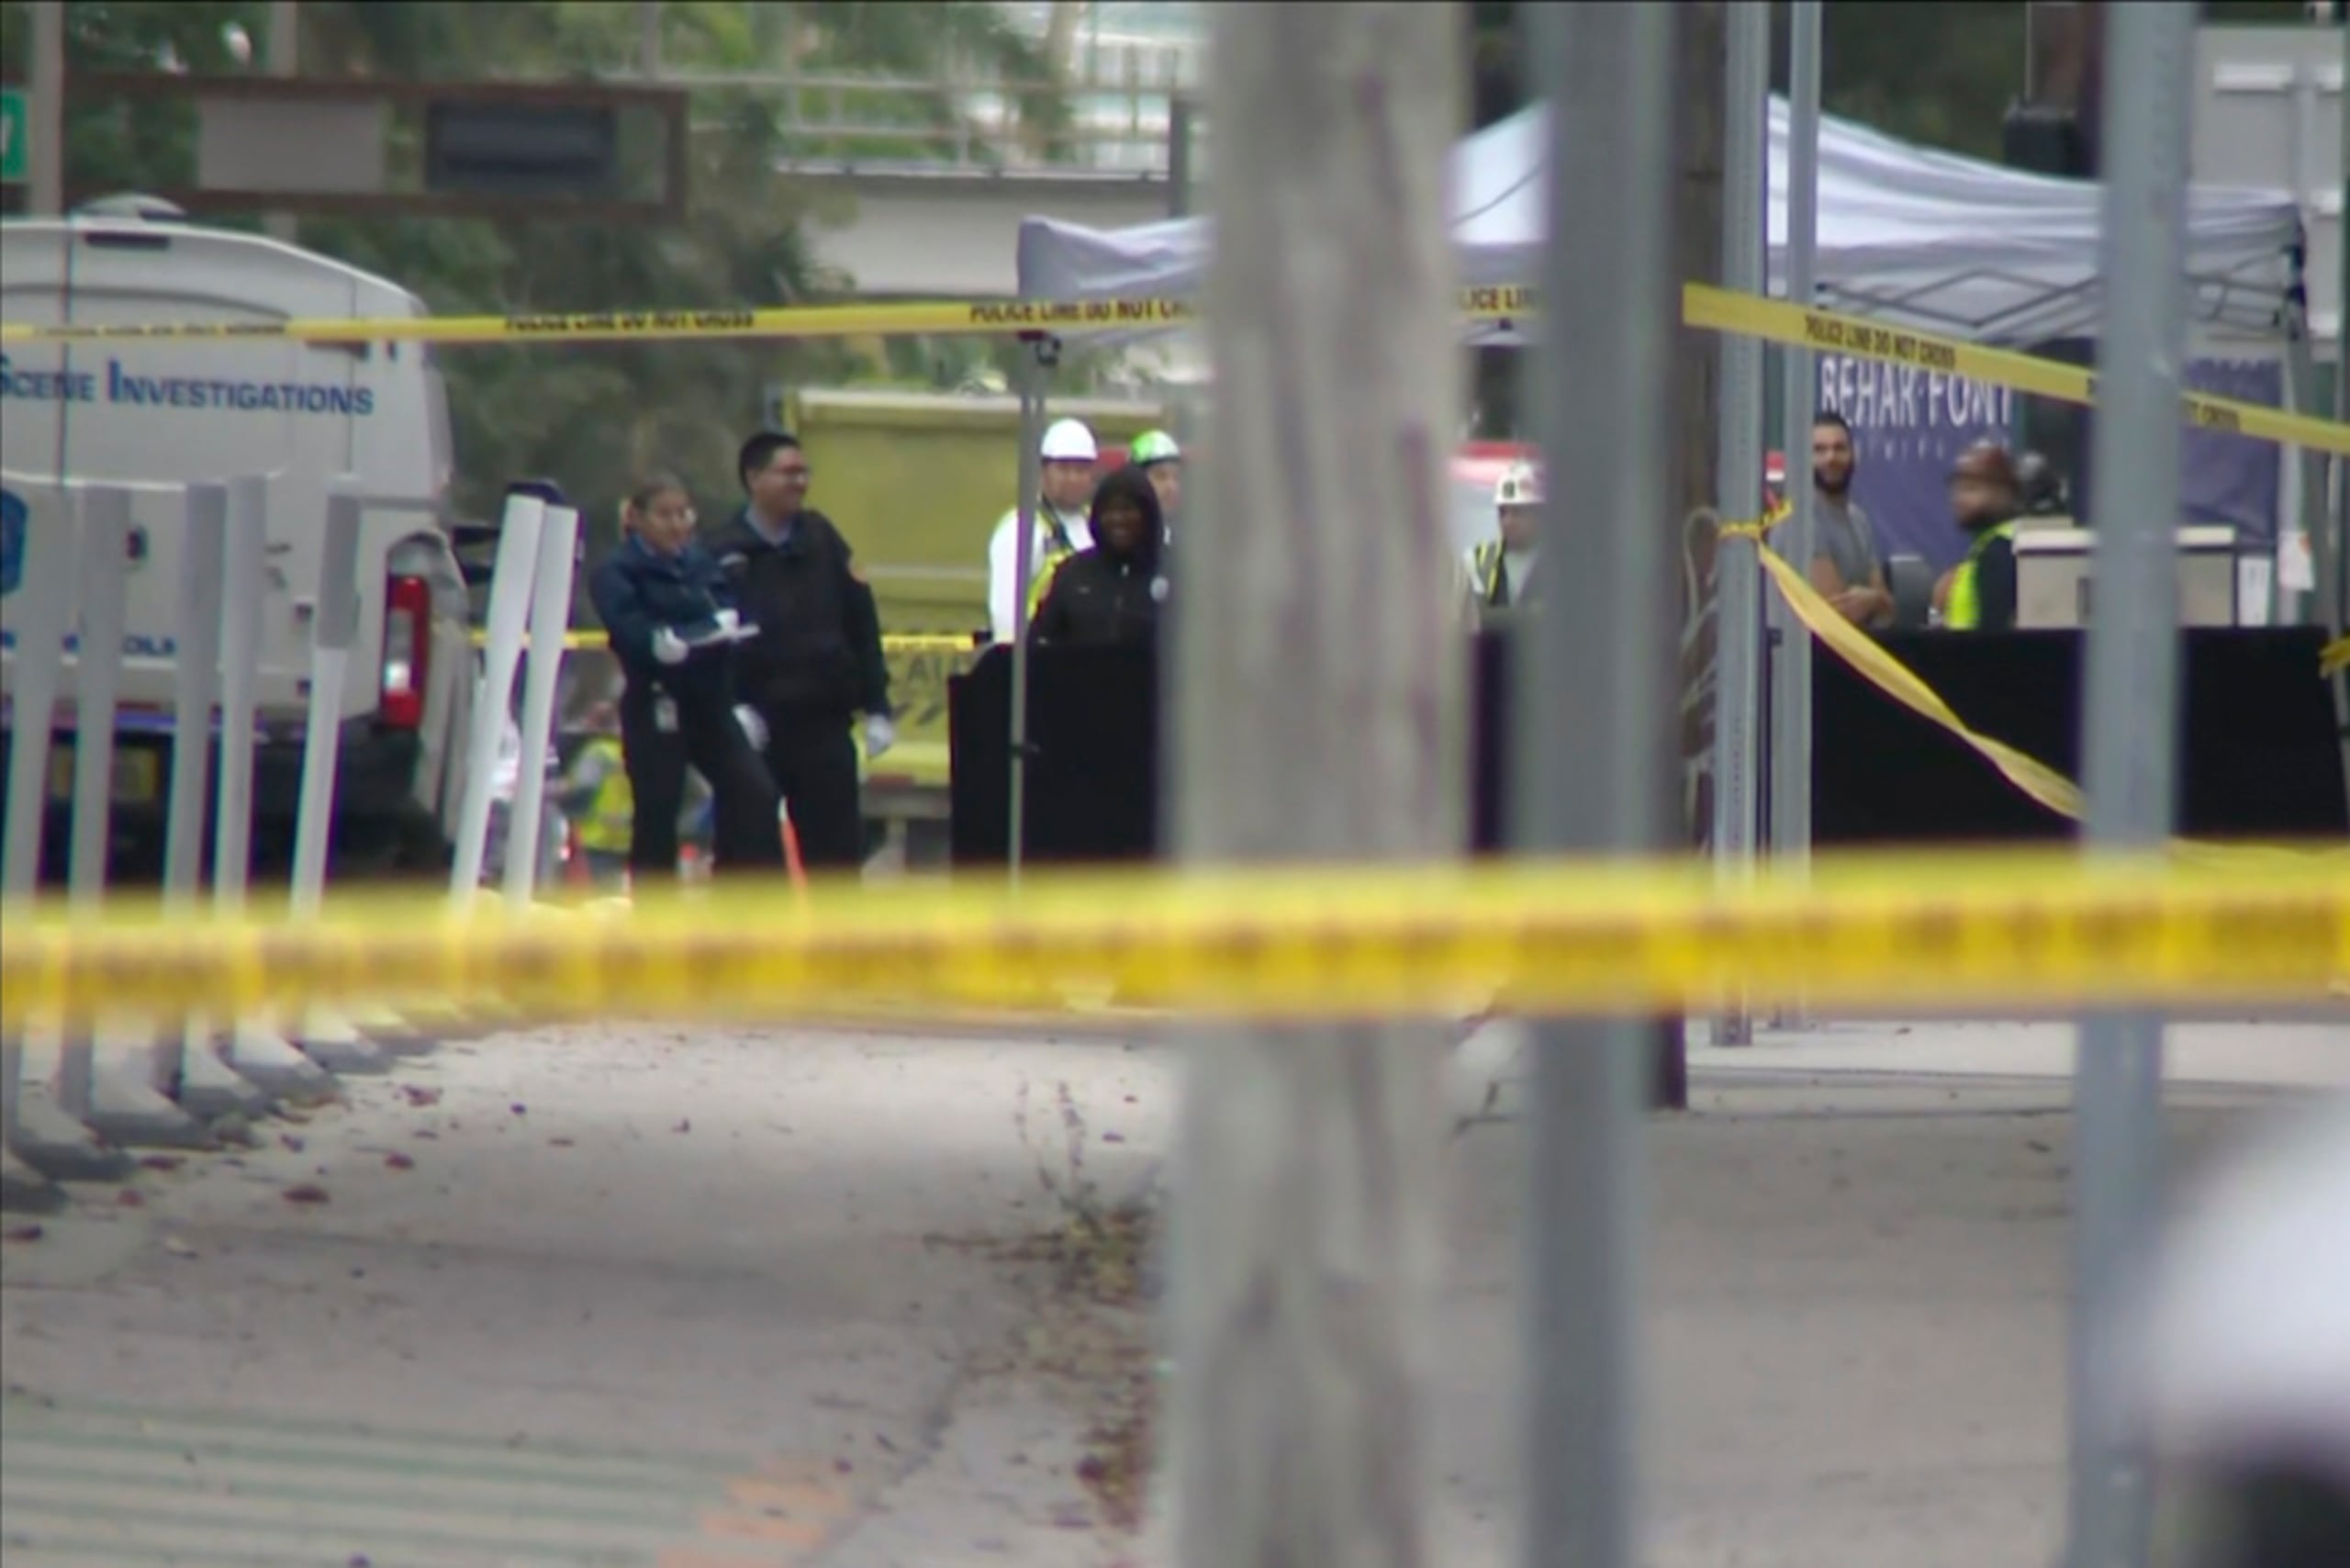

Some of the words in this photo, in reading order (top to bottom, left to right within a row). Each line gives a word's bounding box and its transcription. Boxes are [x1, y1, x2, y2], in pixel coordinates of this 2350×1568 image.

[970, 305, 1034, 322] POLICE
[1039, 303, 1080, 321] LINE
[1085, 302, 1112, 320] DO
[1117, 300, 1154, 319] NOT
[108, 359, 374, 415] INVESTIGATIONS
